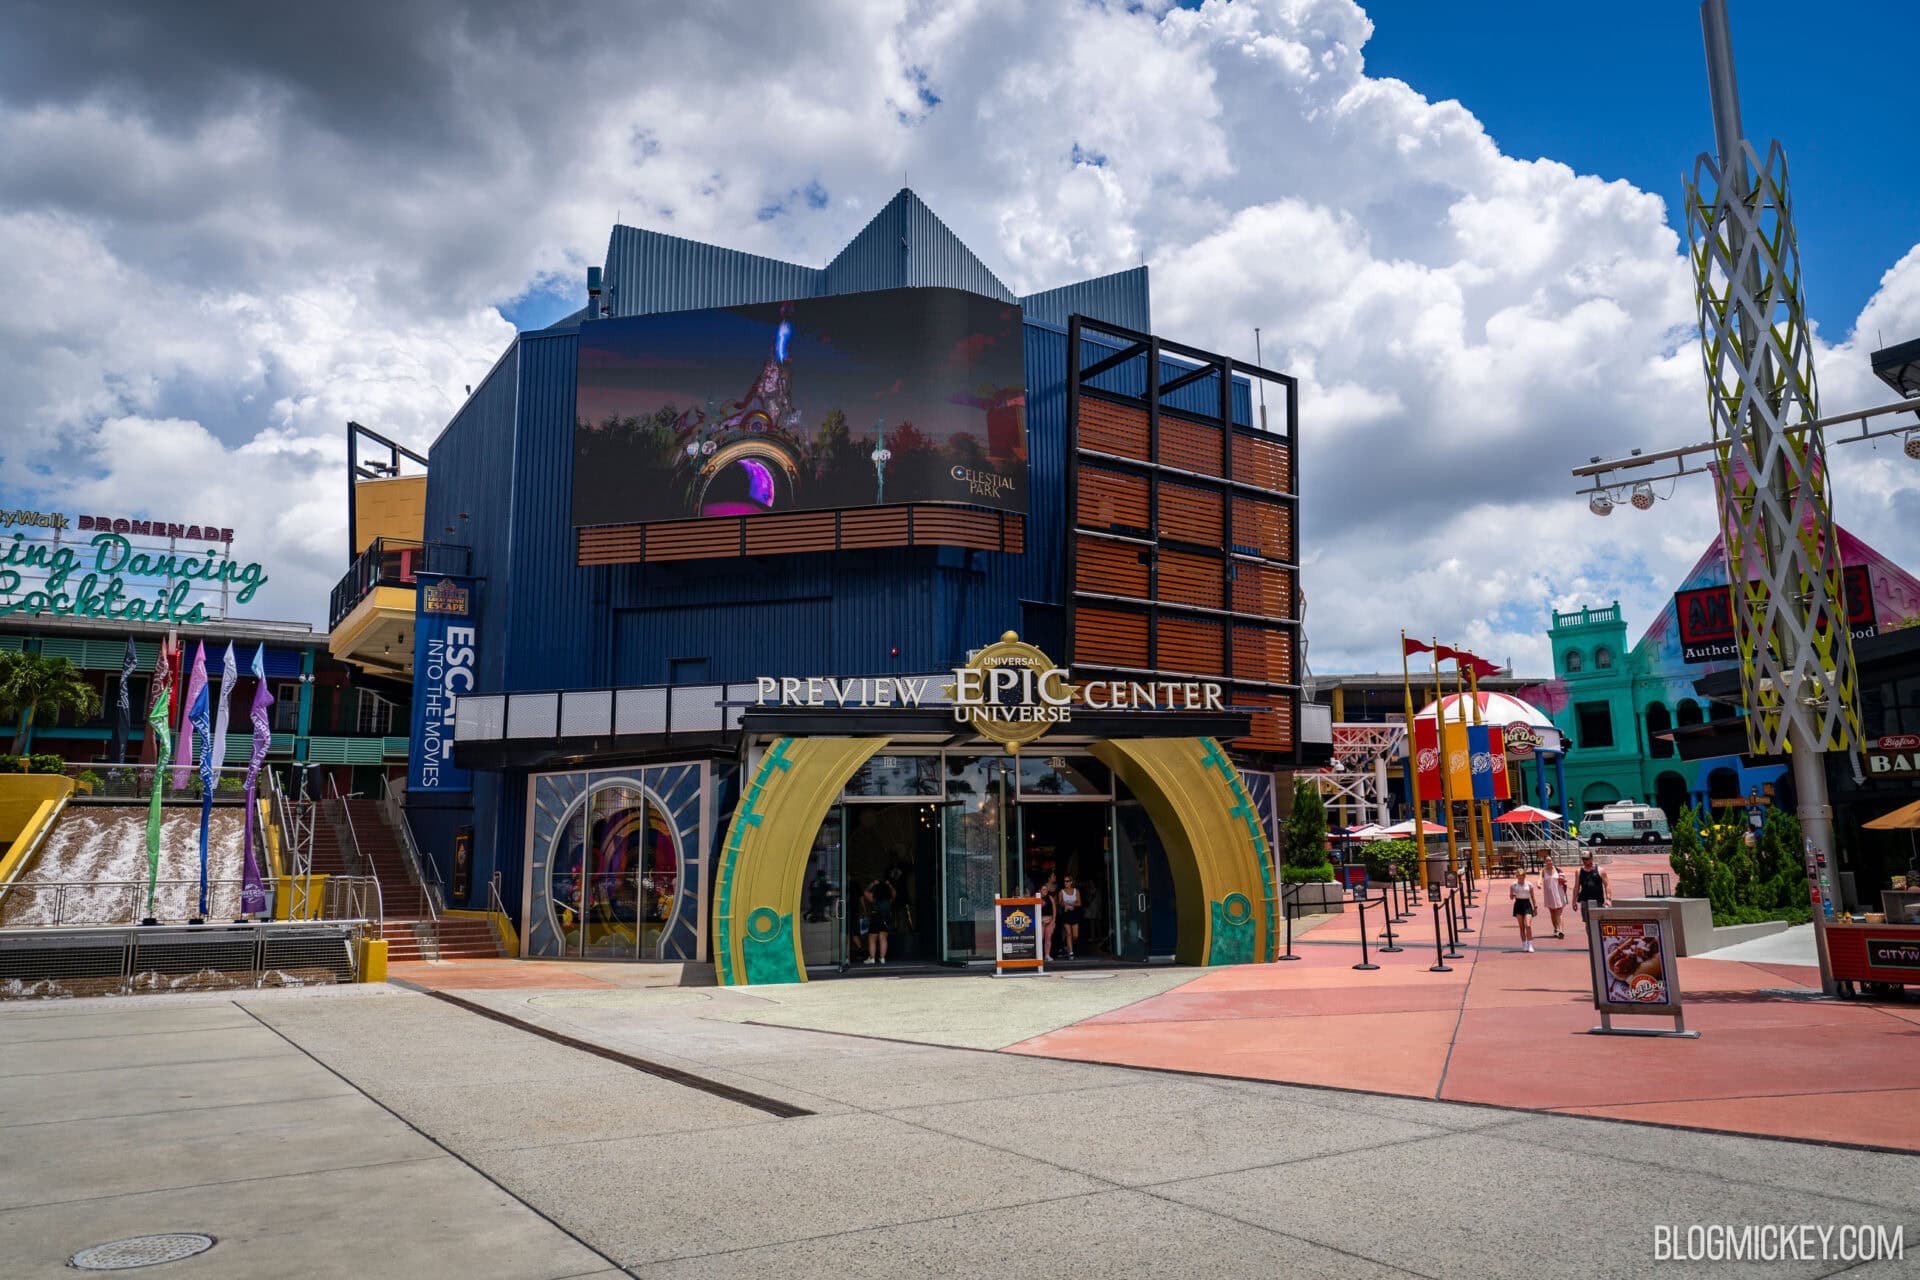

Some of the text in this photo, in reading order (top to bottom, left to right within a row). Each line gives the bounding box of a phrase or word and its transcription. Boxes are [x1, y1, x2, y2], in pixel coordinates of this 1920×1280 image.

[951, 465, 1015, 490] CELESTIAL
[970, 481, 1001, 498] PARK
[78, 515, 234, 544] PROMENADE
[91, 533, 268, 604] Dancing
[983, 656, 1041, 667] UNIVERSAL
[755, 667, 1226, 712] PREVIEW EPIC CENTER
[422, 639, 443, 787] INTO THE MOVIES
[953, 706, 1072, 723] UNIVERSE
[1884, 737, 1916, 748] Bigfire
